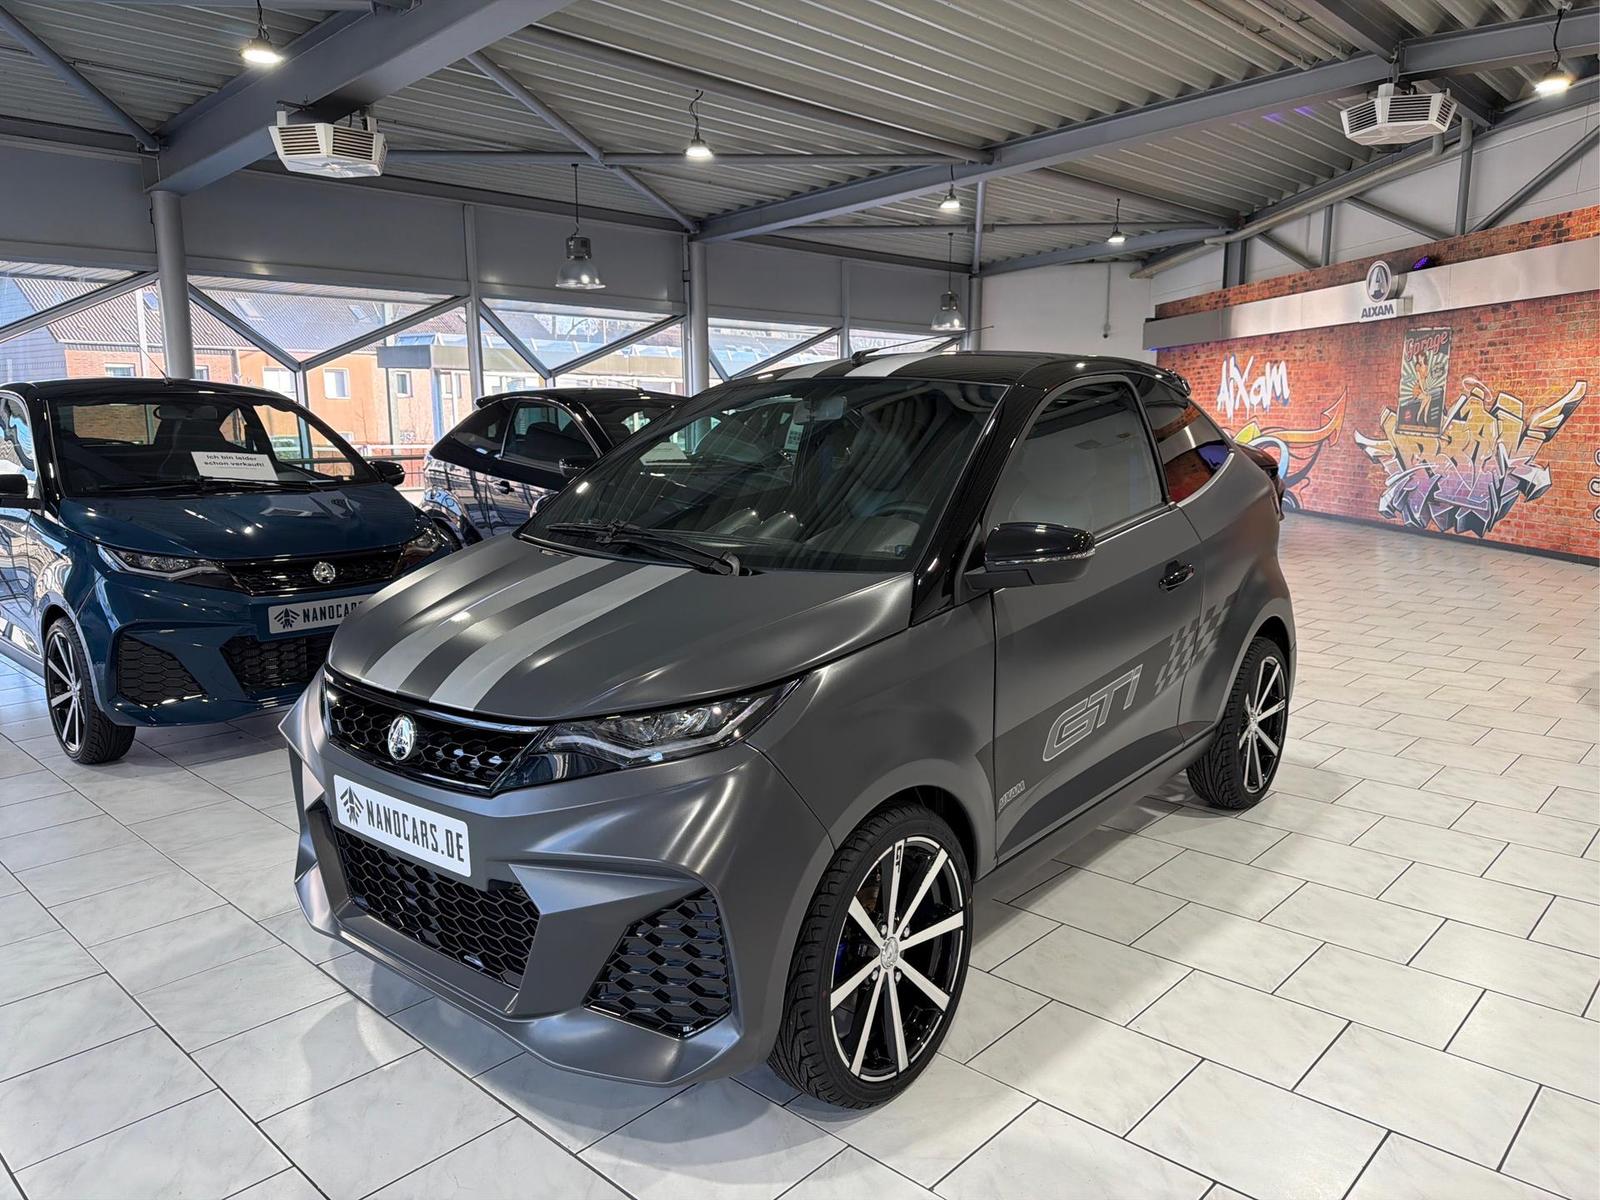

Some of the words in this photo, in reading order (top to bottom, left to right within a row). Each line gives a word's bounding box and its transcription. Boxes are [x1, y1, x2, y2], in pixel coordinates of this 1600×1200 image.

[1361, 303, 1394, 318] AIXAM
[1406, 331, 1449, 362] Garage
[302, 601, 364, 623] NANOCA
[366, 798, 465, 863] NANOCARS.DE
